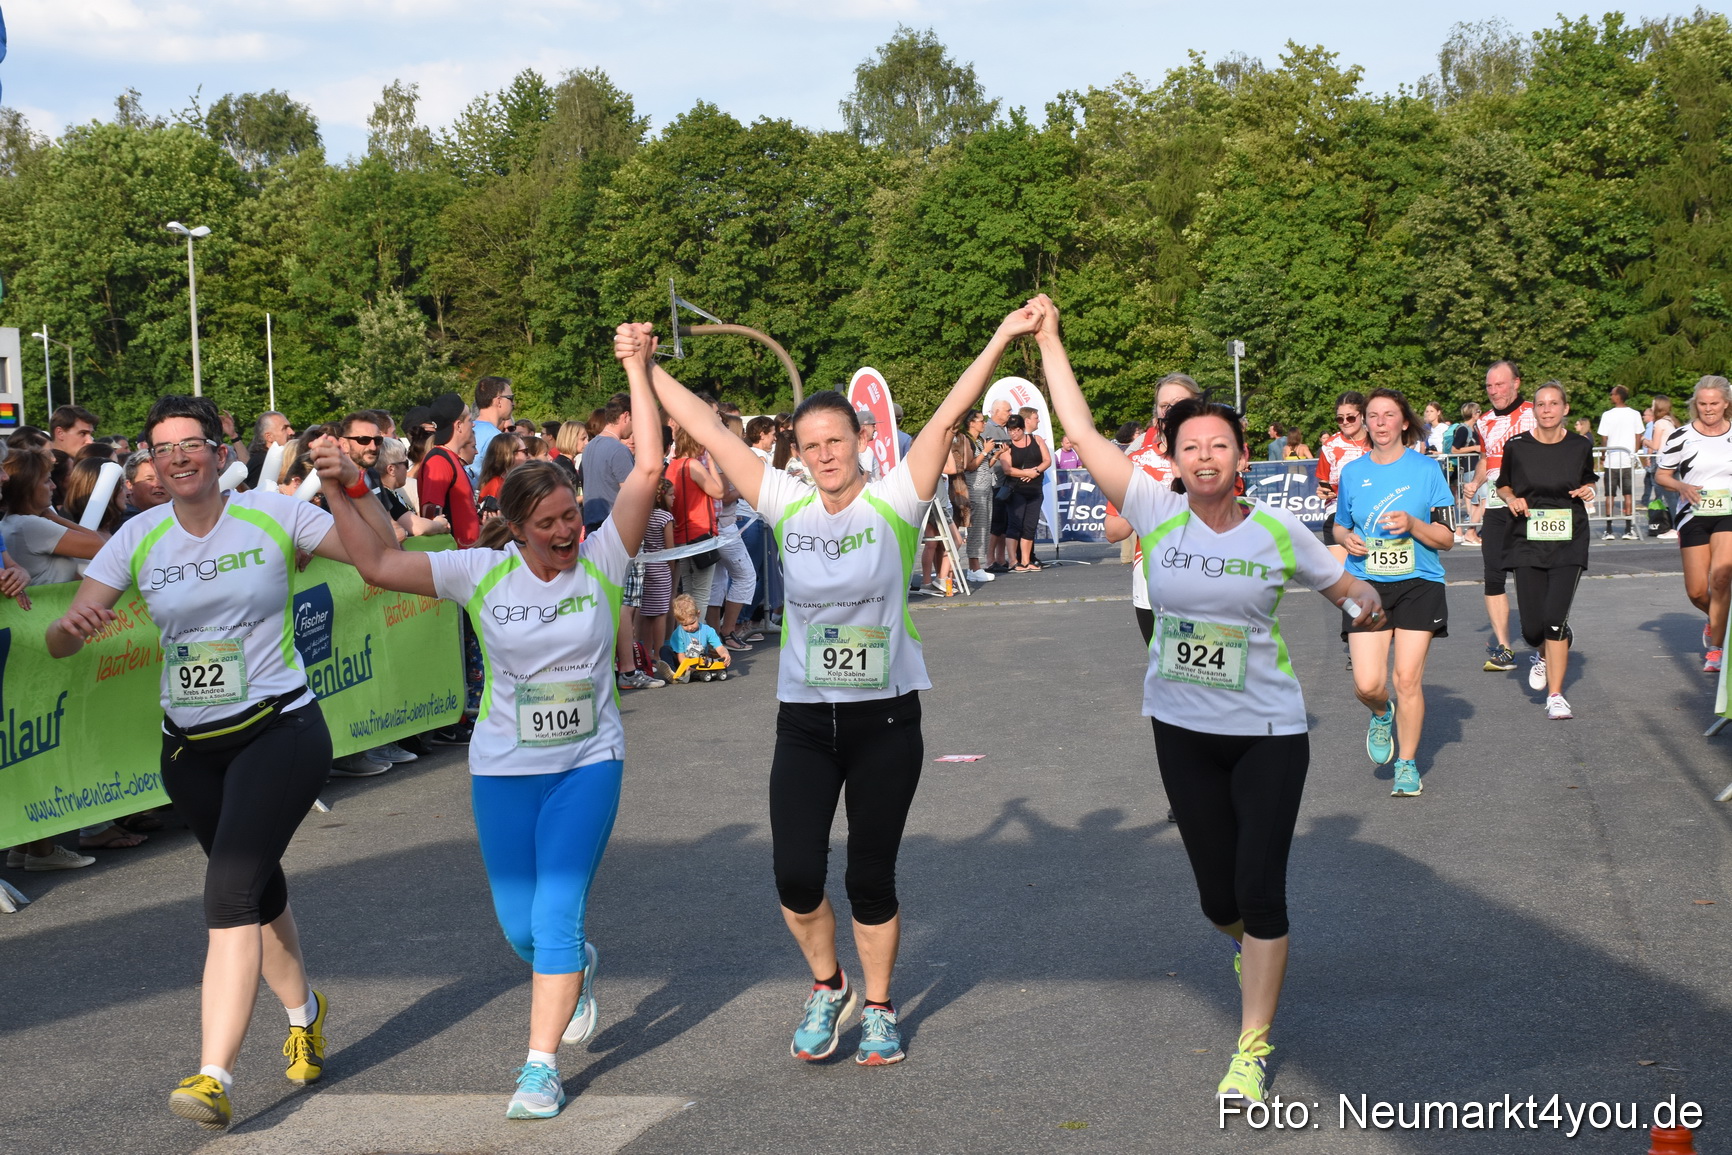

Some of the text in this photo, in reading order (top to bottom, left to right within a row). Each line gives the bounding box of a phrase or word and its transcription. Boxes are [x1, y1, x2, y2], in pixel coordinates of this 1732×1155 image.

[1057, 500, 1106, 520] Fisc
[1364, 484, 1411, 530] Team Schick Bau
[1533, 520, 1566, 532] 1868
[785, 527, 876, 560] gangart
[151, 548, 266, 590] gangart
[1161, 547, 1271, 580] gangart
[1371, 551, 1408, 565] 1535
[300, 610, 329, 631] Fischer
[493, 593, 598, 625] gangart
[96, 639, 151, 683] laufen
[823, 647, 867, 670] 921
[1177, 641, 1226, 670] 924
[179, 664, 225, 689] 922
[827, 670, 866, 678] Kolp Sabine
[1174, 663, 1227, 678] Steiner Susanne
[350, 689, 458, 738] www.firmenlauf-oberpfalz.de
[532, 707, 581, 732] 9104
